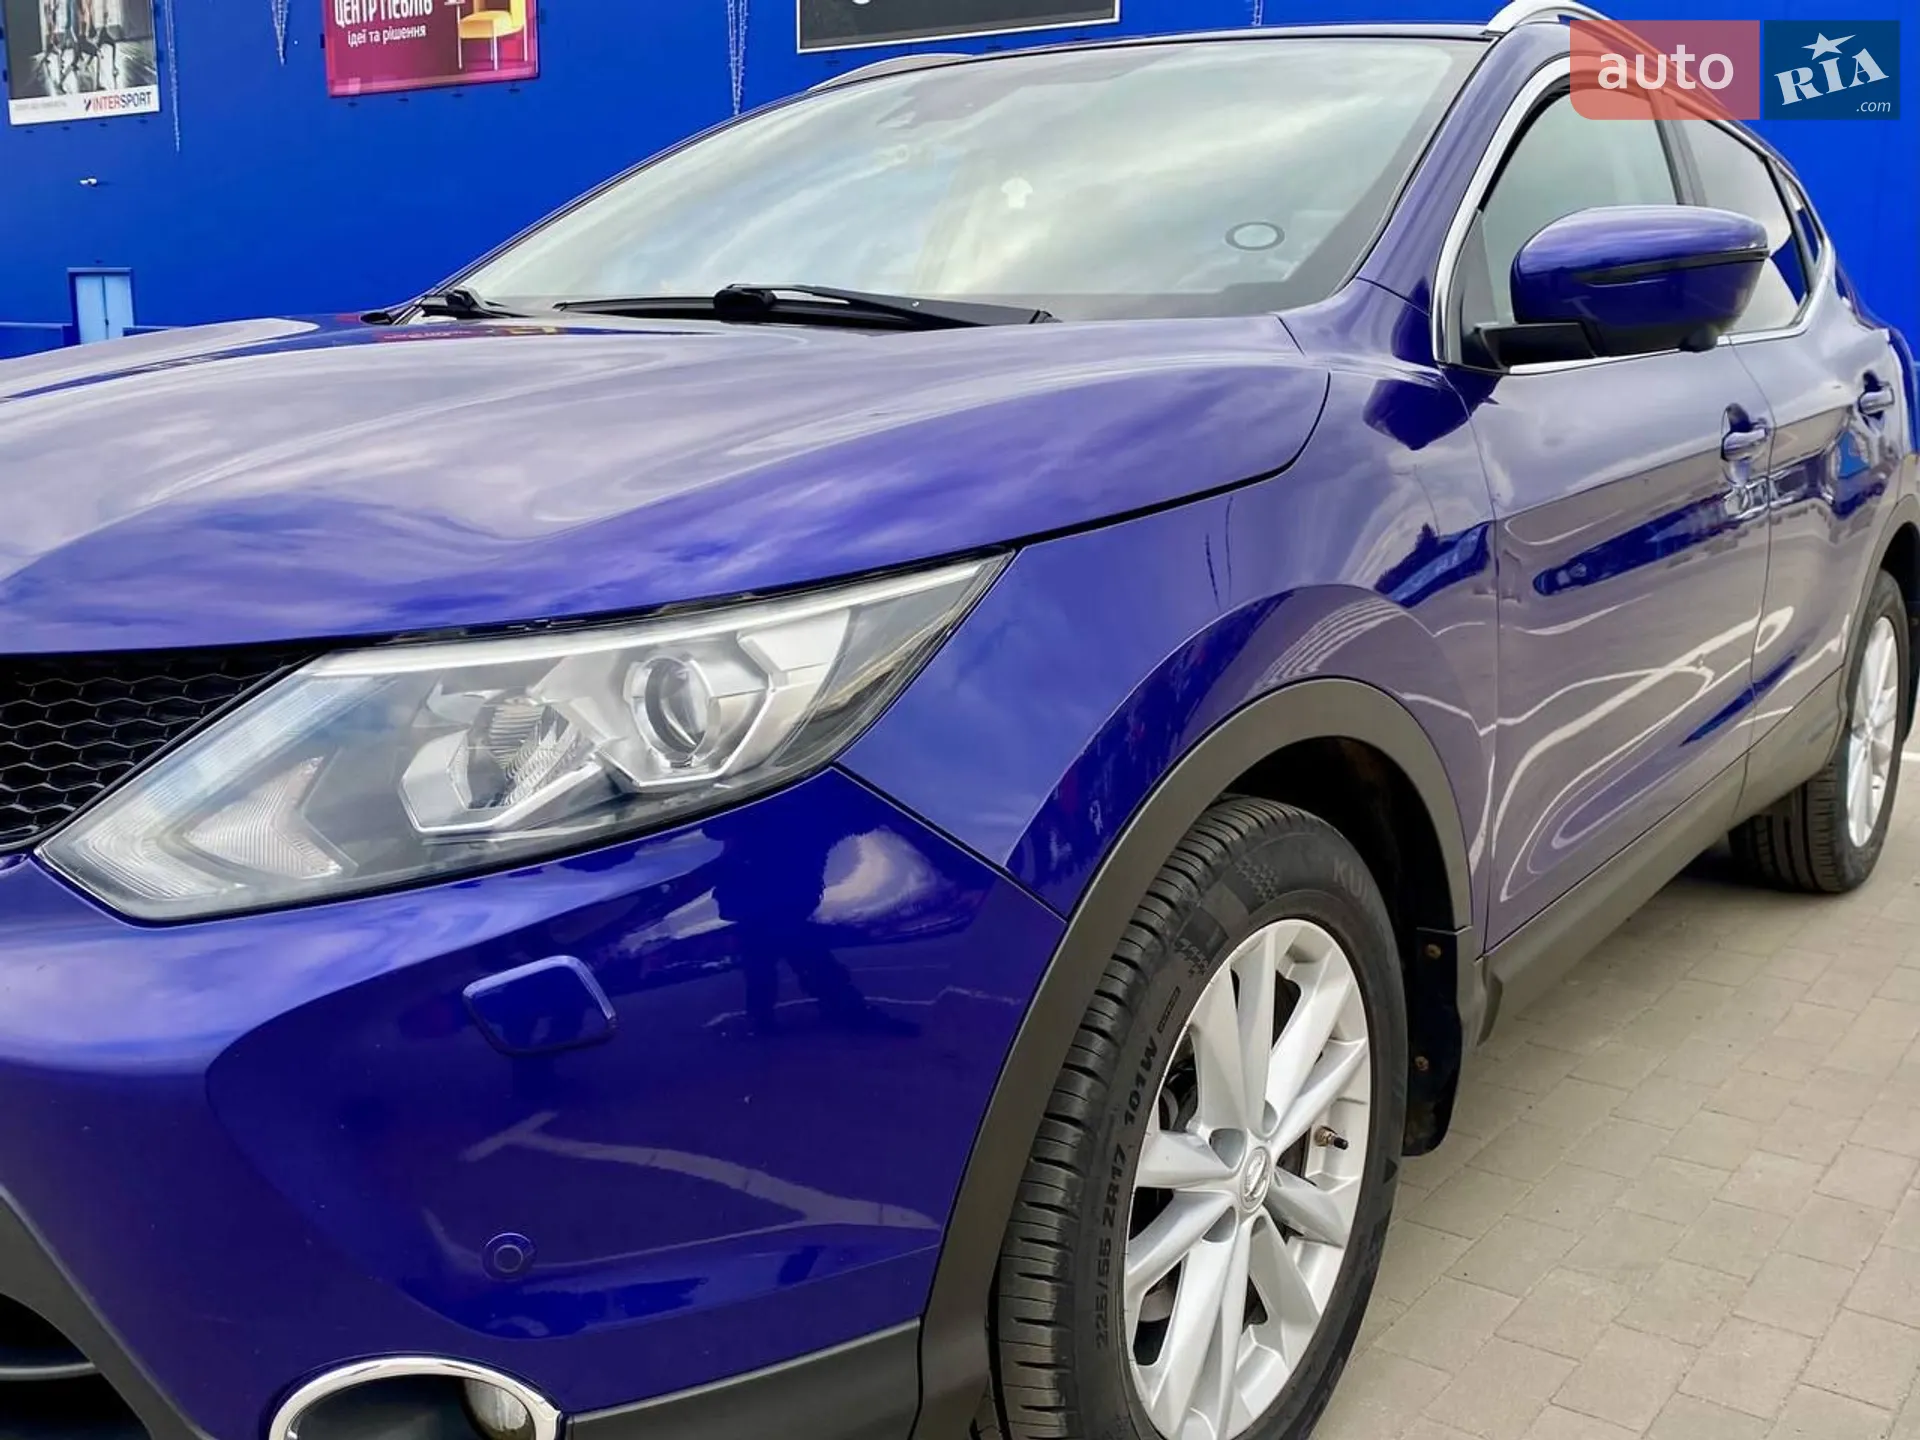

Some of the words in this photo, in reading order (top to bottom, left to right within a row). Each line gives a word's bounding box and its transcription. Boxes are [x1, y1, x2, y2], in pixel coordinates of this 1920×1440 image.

[347, 29, 367, 48] ідеї
[368, 30, 381, 43] та
[382, 25, 427, 45] рішення
[93, 91, 152, 112] INTERSPORT
[1124, 1034, 1158, 1127] 101W
[1101, 1143, 1127, 1229] ZR17
[1094, 1237, 1112, 1350] 225/55
